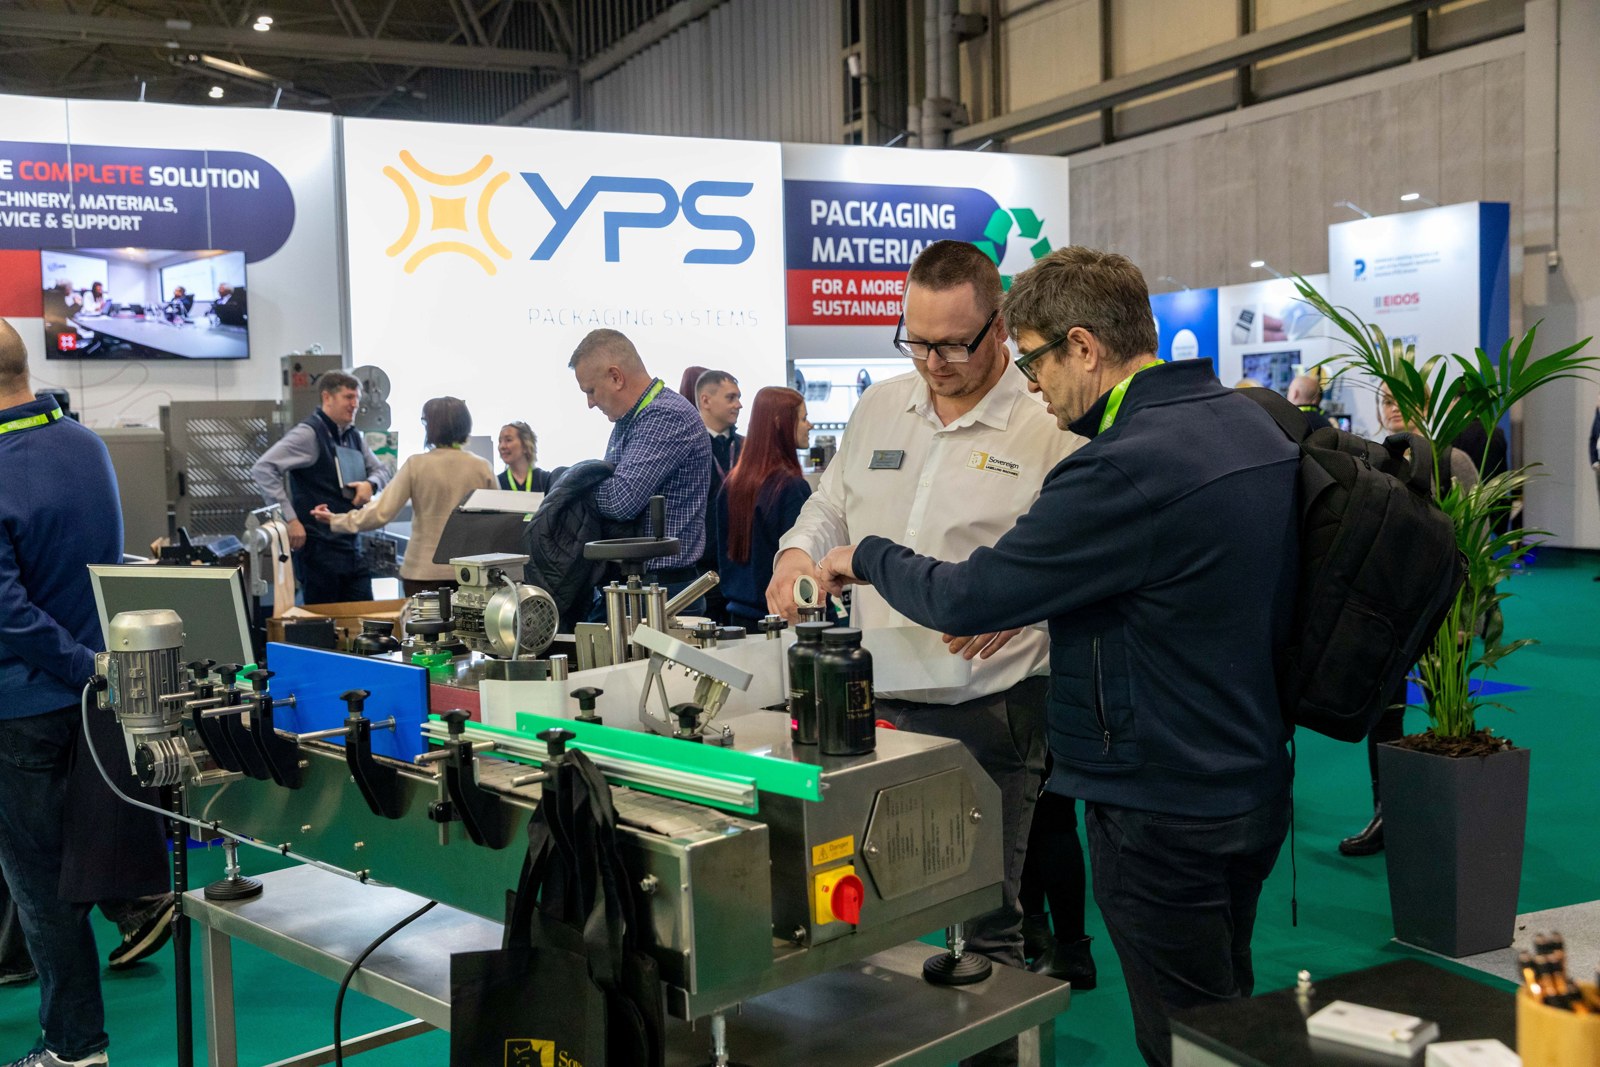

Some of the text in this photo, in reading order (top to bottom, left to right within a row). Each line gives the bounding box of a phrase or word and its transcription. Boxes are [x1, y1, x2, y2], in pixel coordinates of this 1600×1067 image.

[19, 161, 144, 186] COMPLETE
[149, 166, 259, 189] SOLUTION
[80, 194, 178, 214] MATERIALS,
[0, 211, 142, 231] VICE & SUPPORT
[519, 172, 755, 265] YPS
[810, 199, 956, 230] PACKAGING
[811, 236, 933, 265] MATERIA
[812, 279, 904, 295] FOR A MORE
[529, 308, 758, 327] PACKAGING SYSTEMS
[812, 300, 903, 316] SUSTAINABL
[988, 456, 1019, 469] Sovereign
